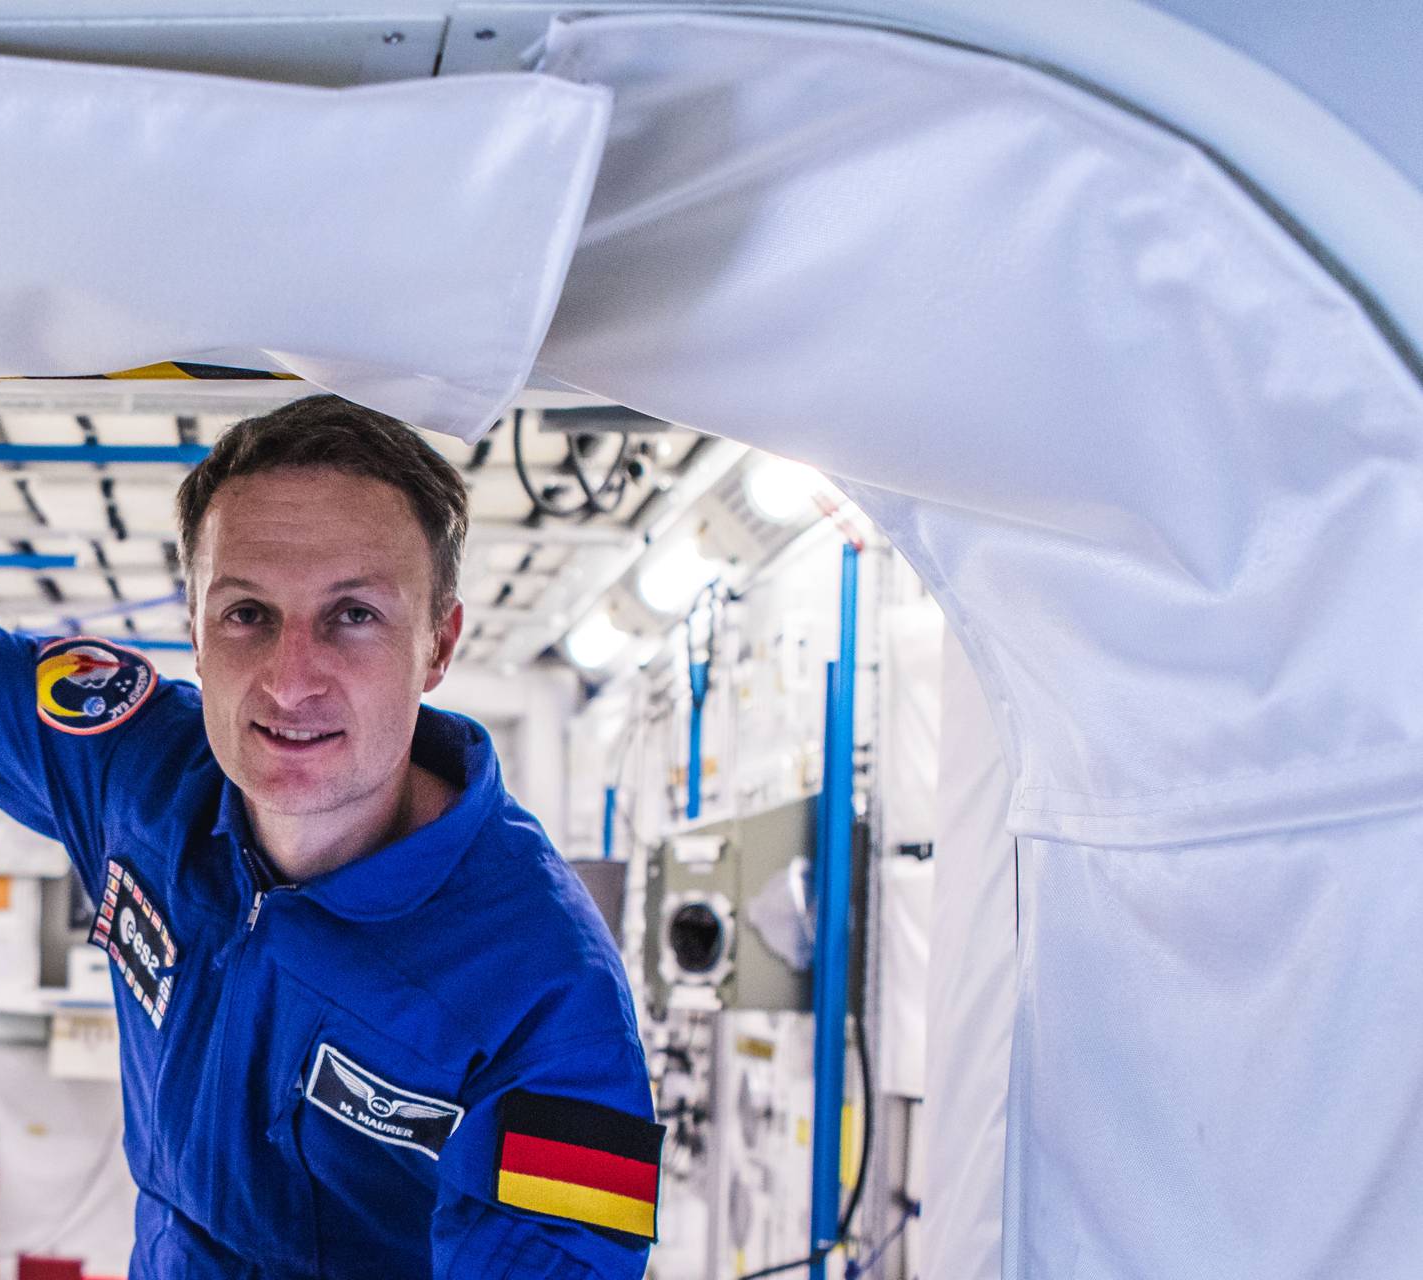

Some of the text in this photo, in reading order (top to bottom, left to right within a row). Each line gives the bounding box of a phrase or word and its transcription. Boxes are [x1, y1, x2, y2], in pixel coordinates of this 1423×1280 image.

[108, 701, 130, 720] EAC
[133, 931, 160, 980] esa
[340, 1101, 354, 1117] M.
[357, 1111, 414, 1138] MAURER
